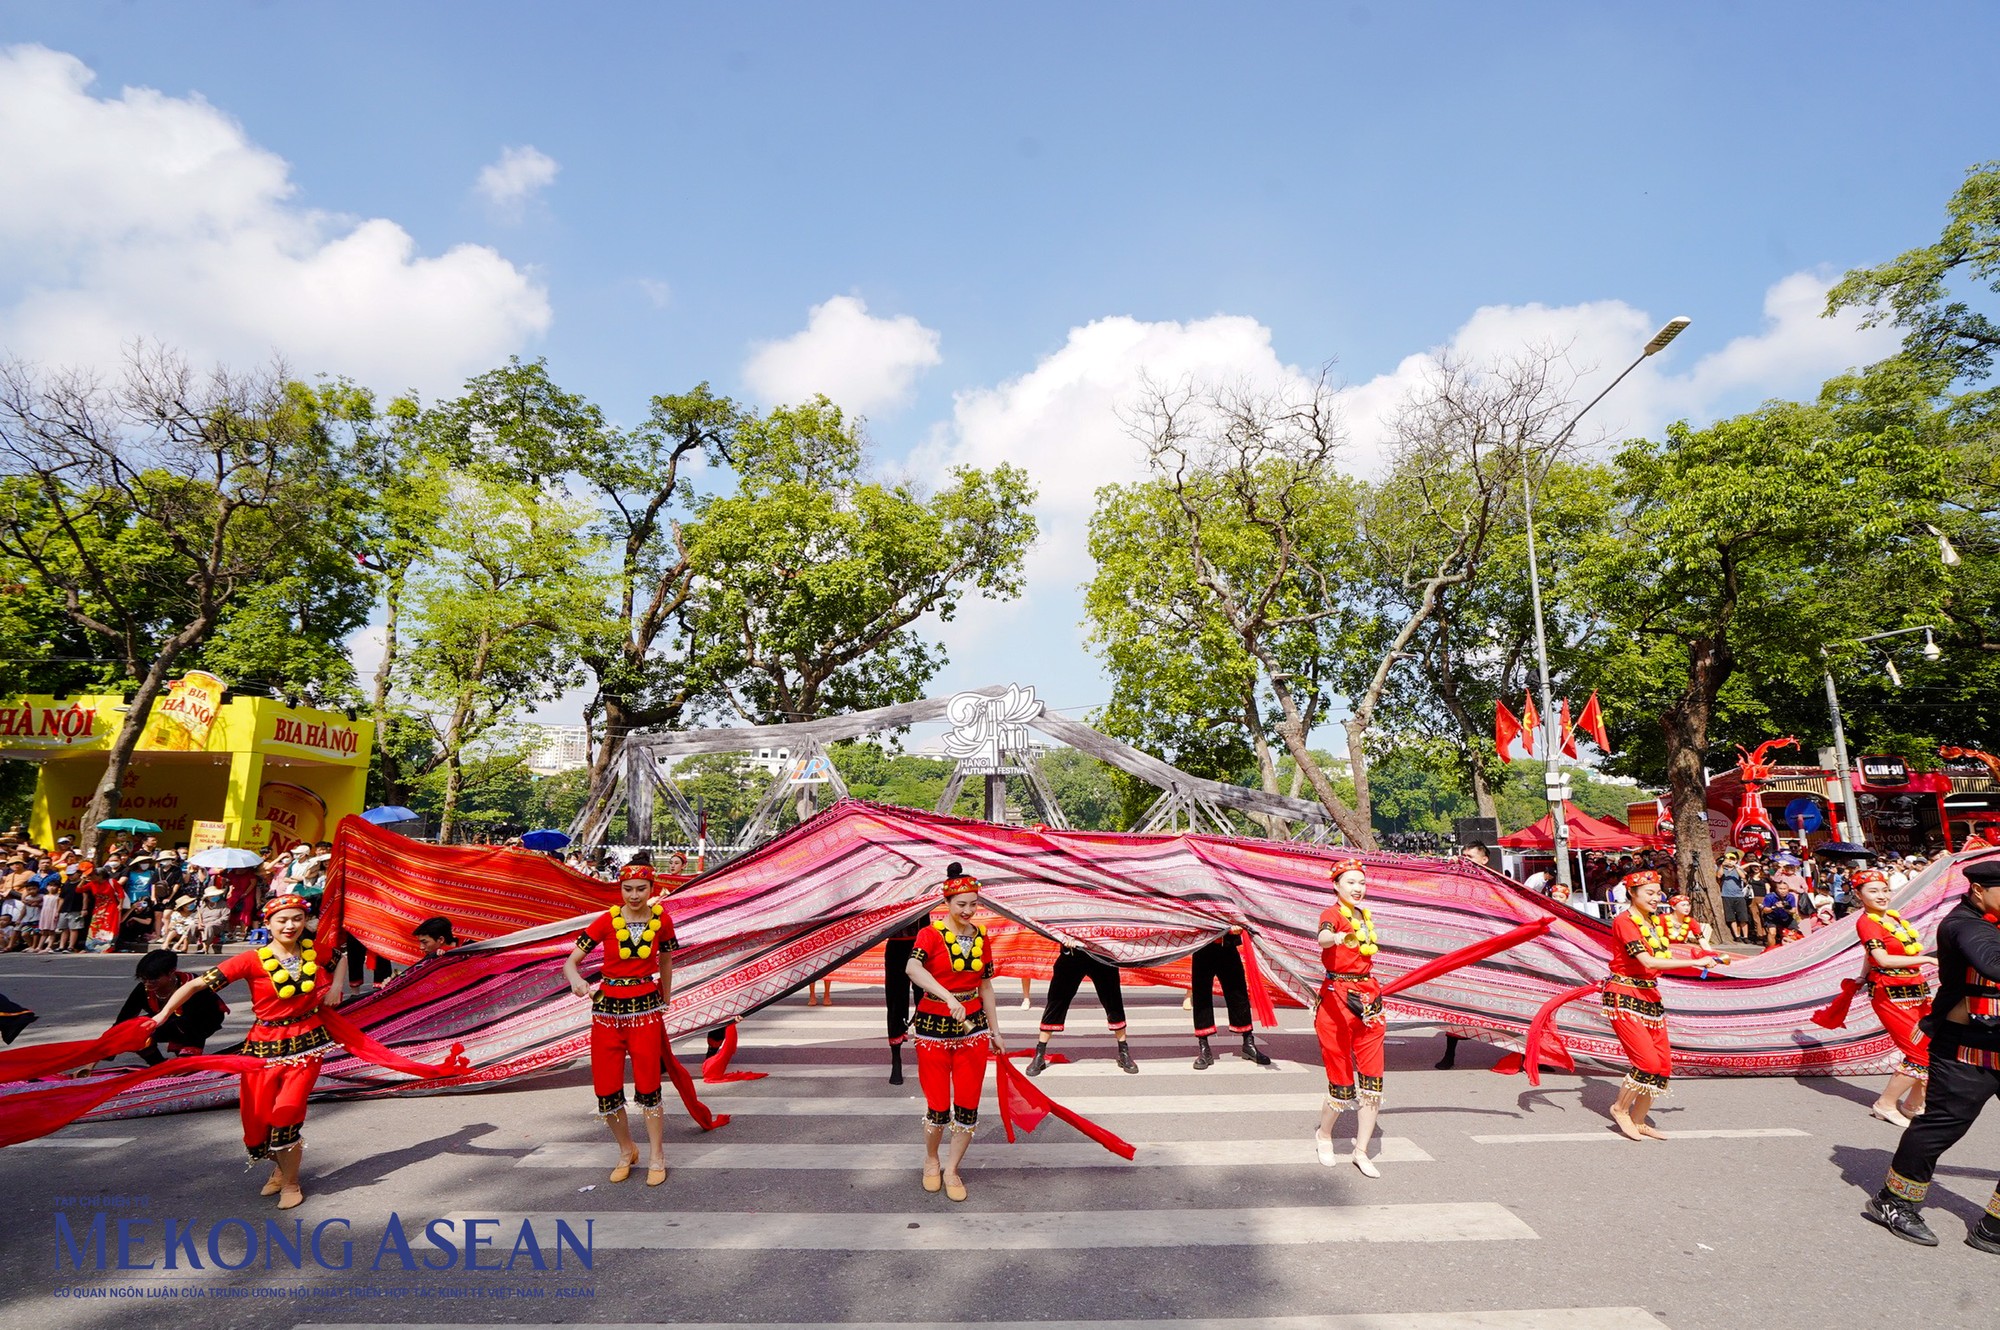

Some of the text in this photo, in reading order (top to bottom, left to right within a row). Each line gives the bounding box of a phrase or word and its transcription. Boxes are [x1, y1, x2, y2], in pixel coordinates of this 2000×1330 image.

[188, 688, 208, 701] BIA
[0, 701, 96, 744] HÀ NỘI
[274, 718, 359, 757] BIA HÀ NỘI
[961, 767, 1028, 775] AUTUMN FESTIVAL
[1865, 764, 1904, 775] CHIN-SU
[265, 807, 297, 830] BIA
